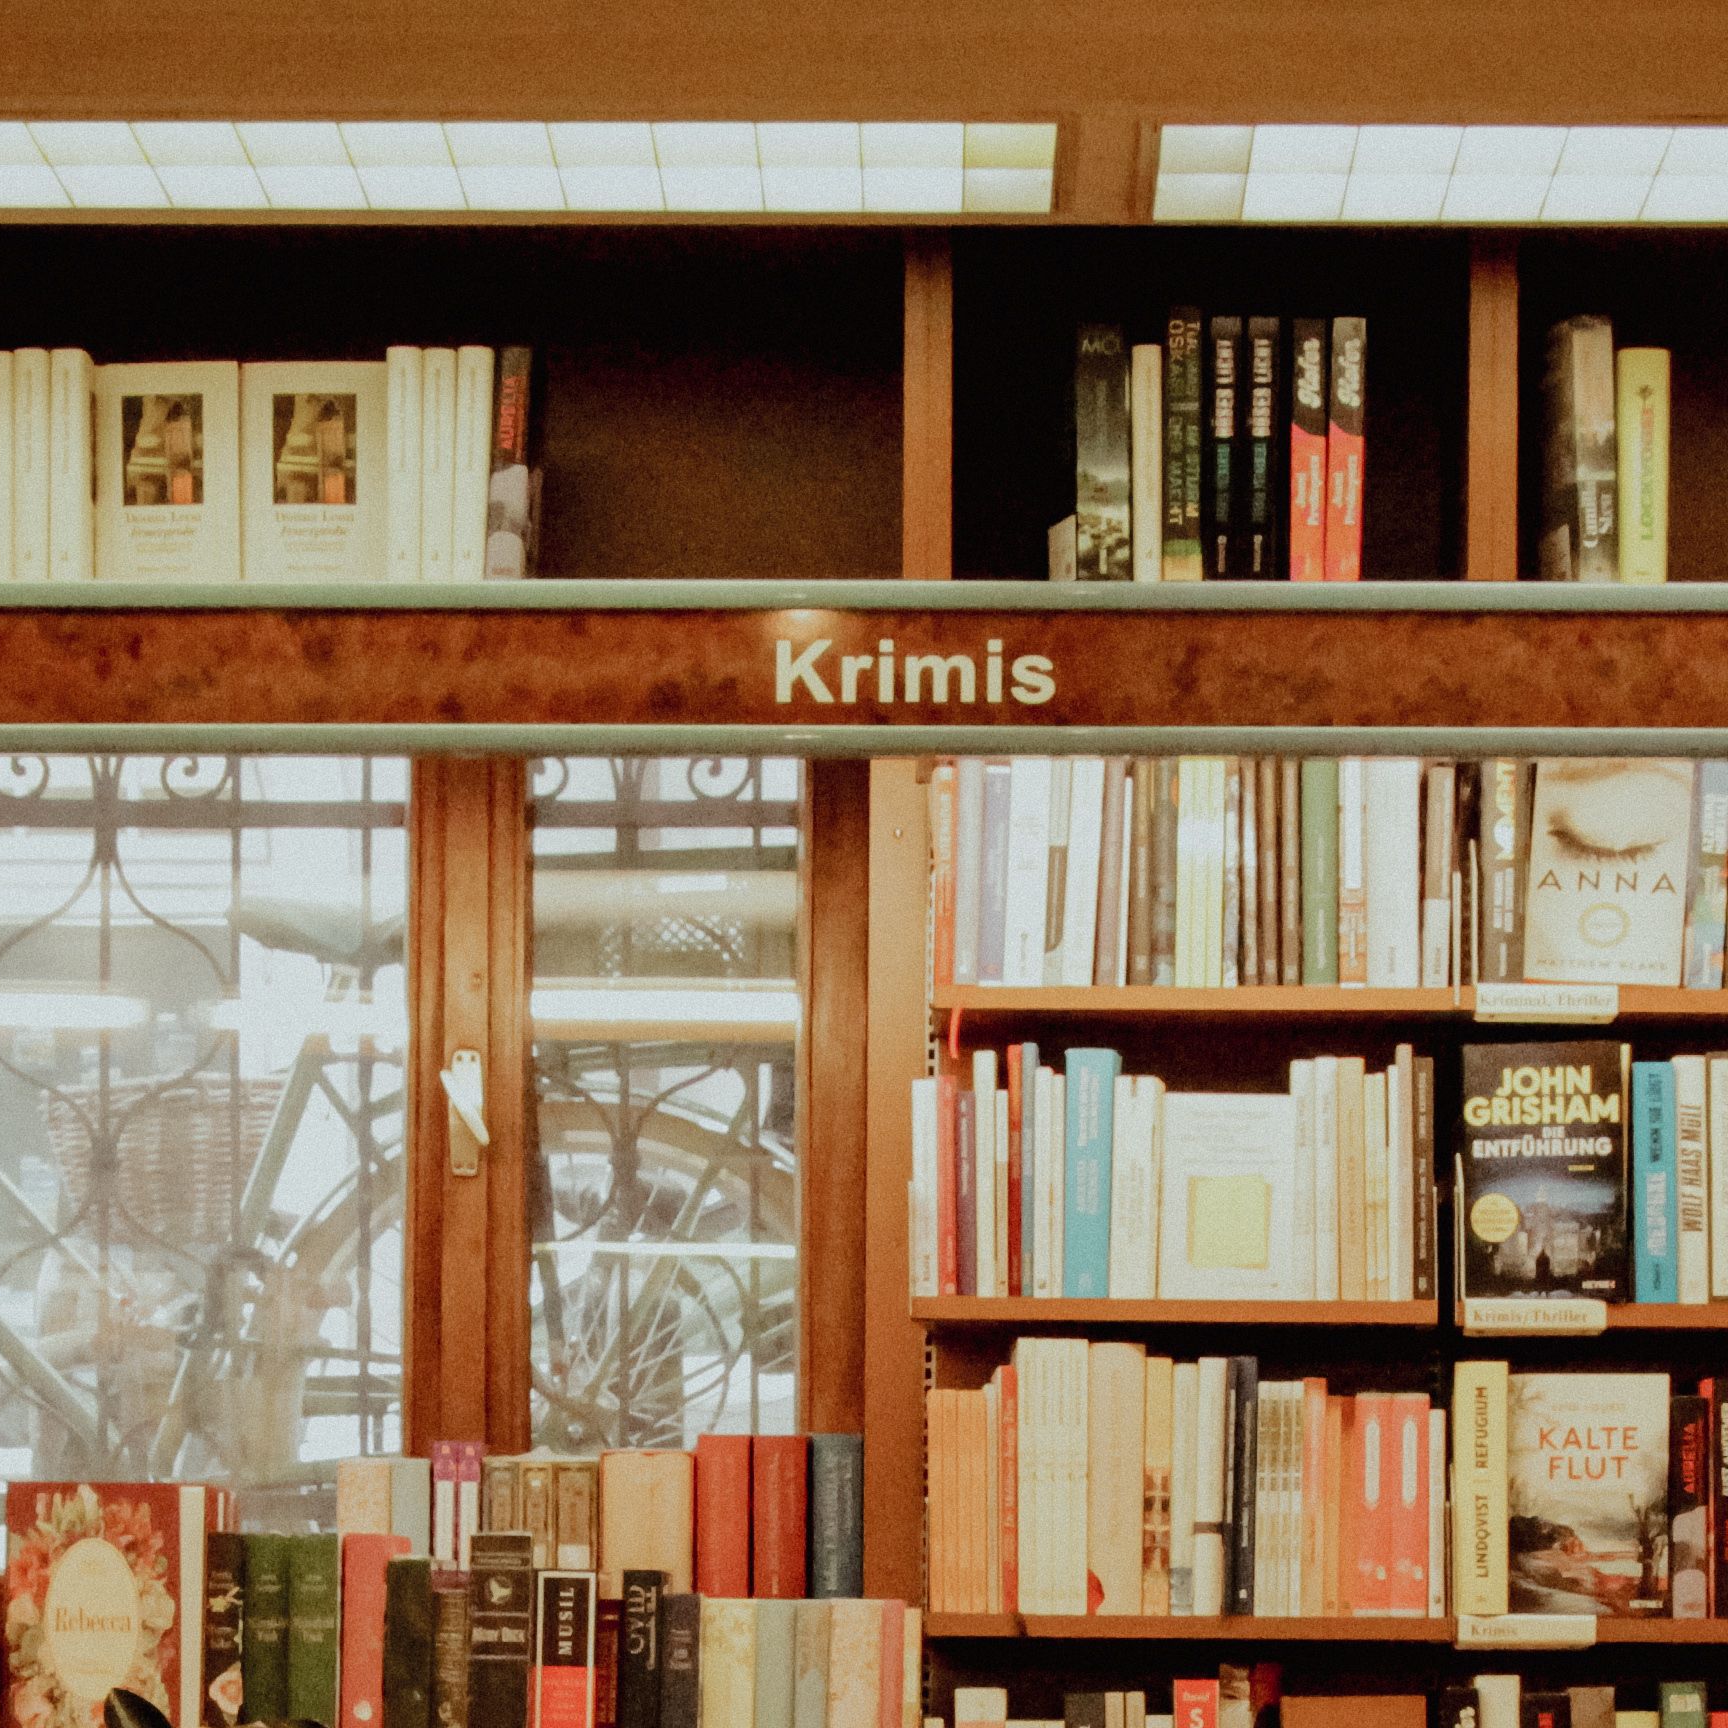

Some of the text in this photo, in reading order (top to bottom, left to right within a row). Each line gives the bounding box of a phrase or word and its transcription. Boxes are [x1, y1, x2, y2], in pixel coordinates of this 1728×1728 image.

[775, 638, 1056, 704] Krimis
[1536, 869, 1678, 895] ANNA
[1496, 1066, 1592, 1096] JOHN
[1464, 1094, 1620, 1126] GRISHAM
[1472, 1134, 1613, 1159] ENTFÜHRUNG
[1540, 1126, 1566, 1139] DIE
[1680, 1146, 1703, 1233] WOLF HAAS
[1538, 1426, 1639, 1451] KALTE
[1548, 1456, 1630, 1480] FLUT
[1475, 1387, 1491, 1580] LINDQVIST REFUGIUM
[53, 1607, 133, 1634] Rebecca
[557, 1586, 575, 1656] MUSIL
